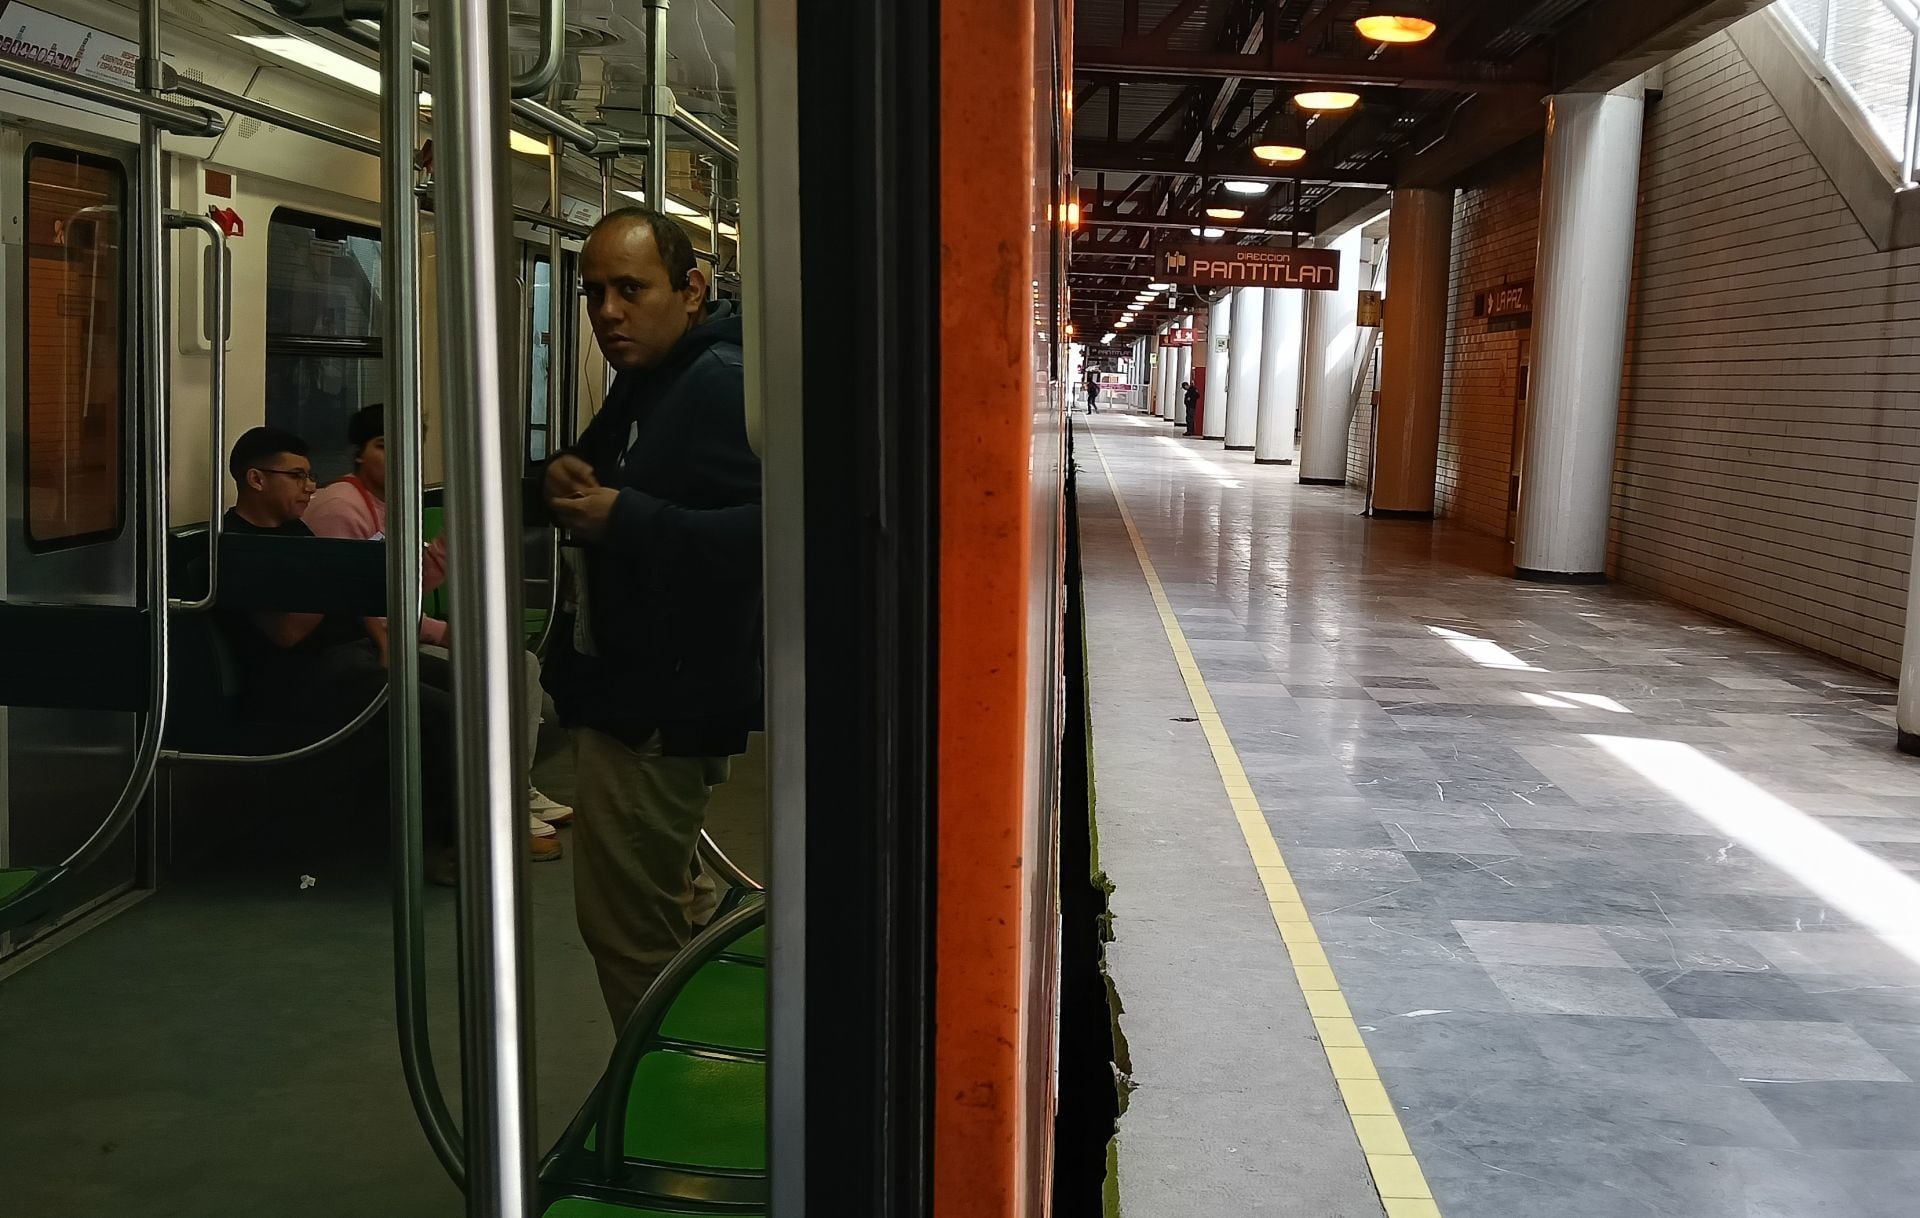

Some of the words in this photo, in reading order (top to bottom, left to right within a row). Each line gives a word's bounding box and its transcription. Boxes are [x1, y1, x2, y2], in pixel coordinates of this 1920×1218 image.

[1237, 252, 1291, 262] DIRECCION
[1193, 260, 1334, 284] PANTITLAN
[1496, 291, 1506, 312] LA
[1507, 288, 1523, 309] PAZ
